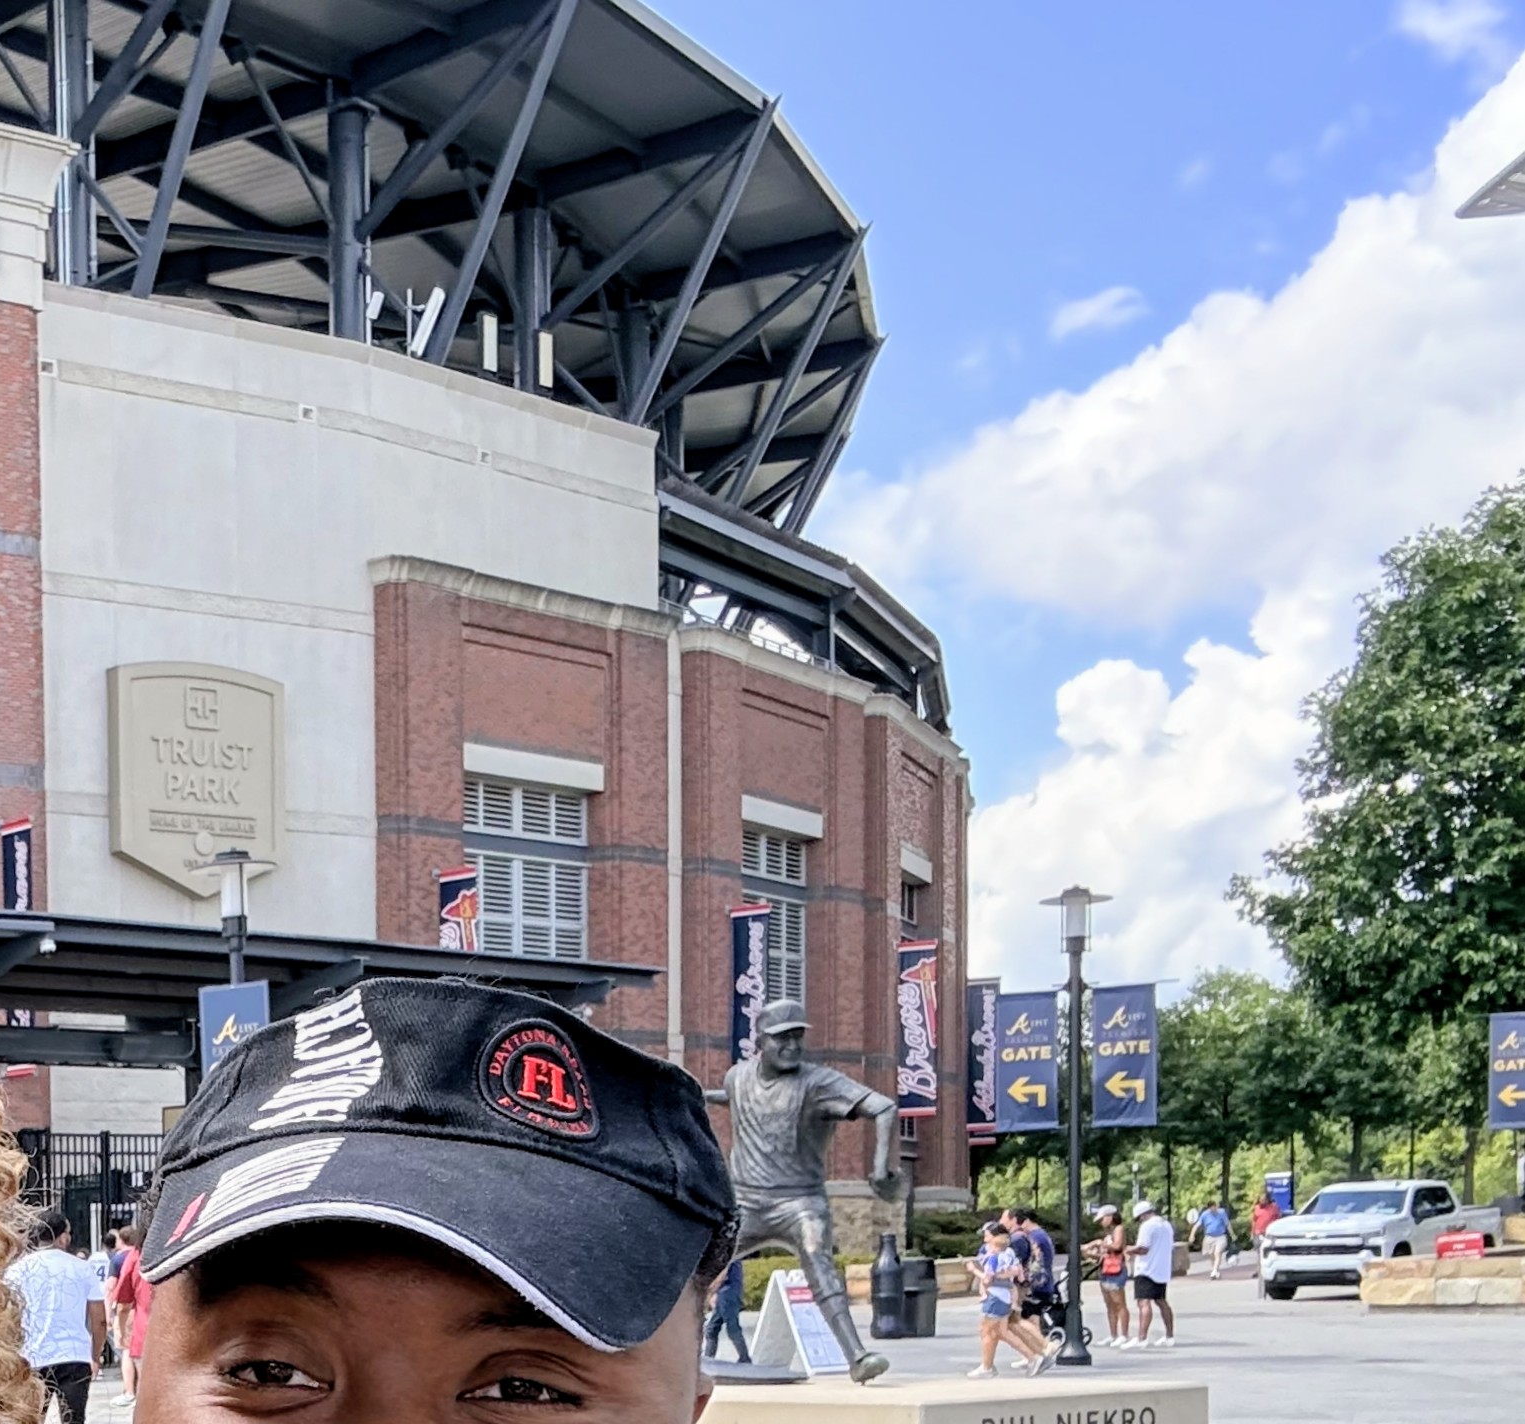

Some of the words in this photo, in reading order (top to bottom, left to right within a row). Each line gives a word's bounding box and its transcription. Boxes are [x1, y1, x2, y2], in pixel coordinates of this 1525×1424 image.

[150, 735, 253, 771] TRUIST
[163, 771, 240, 805] PARK
[488, 1028, 557, 1077] DAYTONA
[897, 982, 937, 1100] Braves
[1001, 1045, 1052, 1062] GATE
[1098, 1039, 1151, 1056] GATE
[517, 1055, 577, 1110] FL
[1493, 1058, 1525, 1073] GAT
